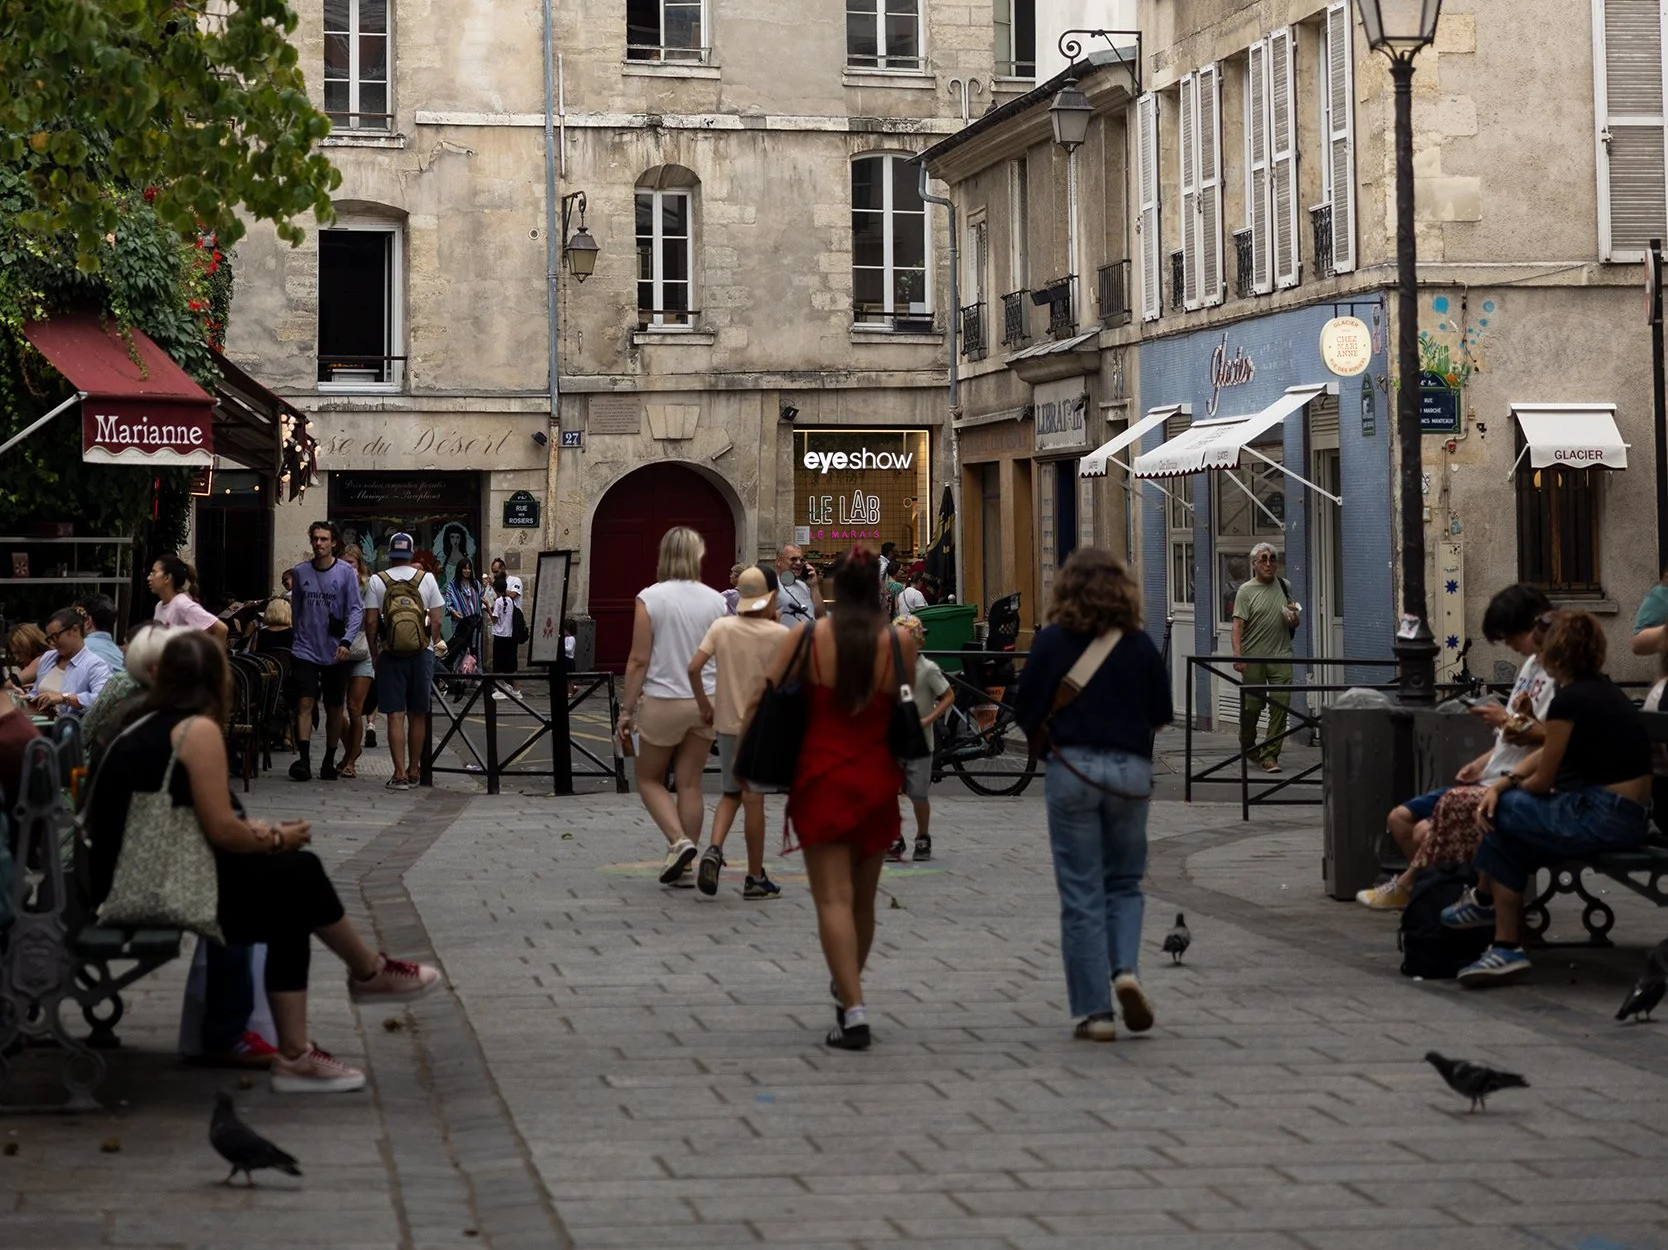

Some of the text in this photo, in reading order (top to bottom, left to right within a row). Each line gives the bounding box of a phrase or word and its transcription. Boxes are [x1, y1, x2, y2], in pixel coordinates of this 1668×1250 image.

[1333, 320, 1359, 328] GLACIER
[1336, 335, 1358, 343] CHEZ
[1336, 350, 1359, 358] ANNE
[94, 415, 203, 445] Marianne
[565, 432, 579, 445] 27
[362, 432, 393, 457] du
[803, 447, 913, 474] eyeshow
[1554, 450, 1604, 460] GLACIER
[809, 489, 880, 524] LE LAB
[809, 530, 824, 539] LE
[831, 530, 880, 539] MARAIS
